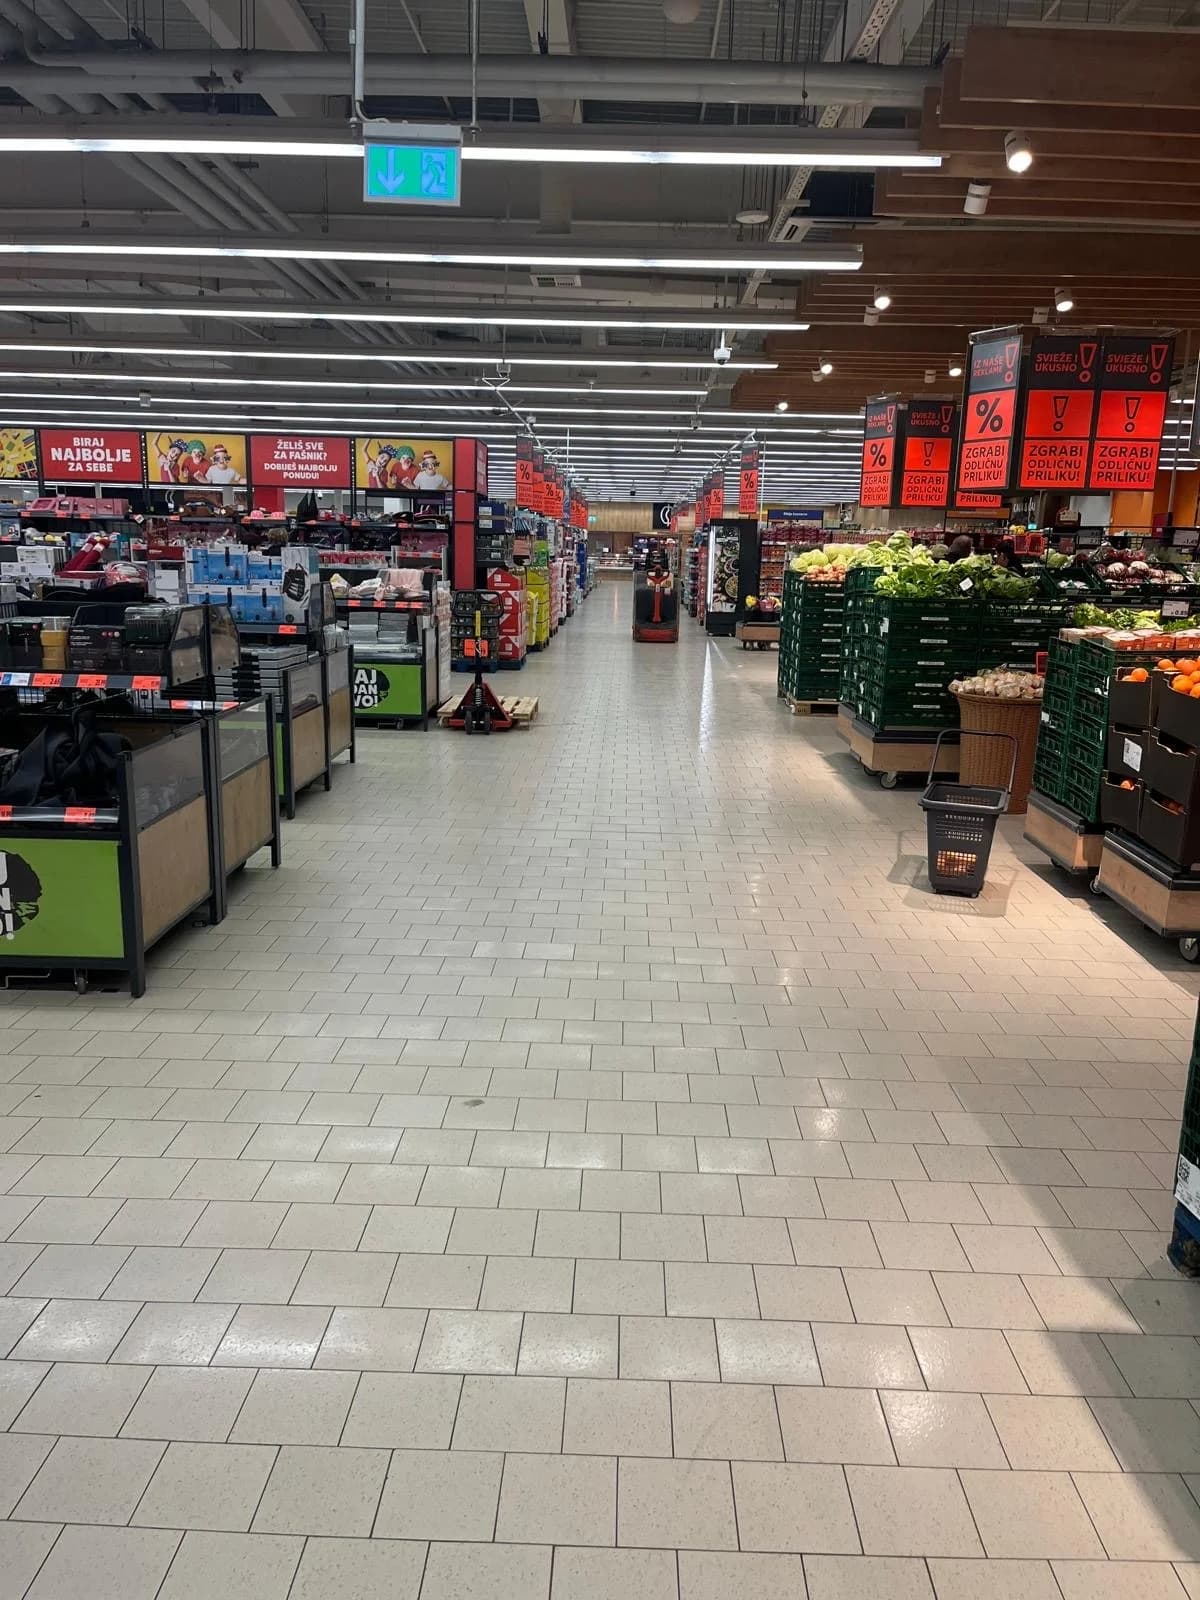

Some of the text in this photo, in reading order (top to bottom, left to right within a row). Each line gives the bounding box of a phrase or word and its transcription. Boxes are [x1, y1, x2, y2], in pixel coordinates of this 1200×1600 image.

[1036, 352, 1072, 363] SVJEŽE
[1106, 353, 1142, 364] SVJEŽE
[1035, 363, 1077, 373] UKUSNO
[1105, 363, 1148, 374] UKUSNO
[73, 437, 105, 447] BIRAJ
[277, 439, 324, 451] ŽELIŠ SVE
[51, 448, 132, 463] NAJBOLJE
[273, 449, 328, 462] ZA FAŠNIK?
[965, 445, 1005, 459] ZGRABI
[1028, 445, 1083, 458] ZGRABI
[1098, 445, 1154, 459] ZGRABI
[68, 462, 114, 474] ZA SEBE
[298, 463, 338, 473] NAJBOLJU
[283, 471, 320, 481] PONUDU!
[864, 475, 889, 486] ZGRABI
[907, 475, 945, 486] ZGRABI
[963, 470, 1002, 482] PRILIKU!
[1026, 470, 1080, 482] PRILIKU!
[1096, 470, 1150, 484] PRILIKU!
[863, 493, 888, 502] PRILIKU!
[906, 493, 943, 502] PRILIKU!
[959, 495, 998, 504] PRILIKU!
